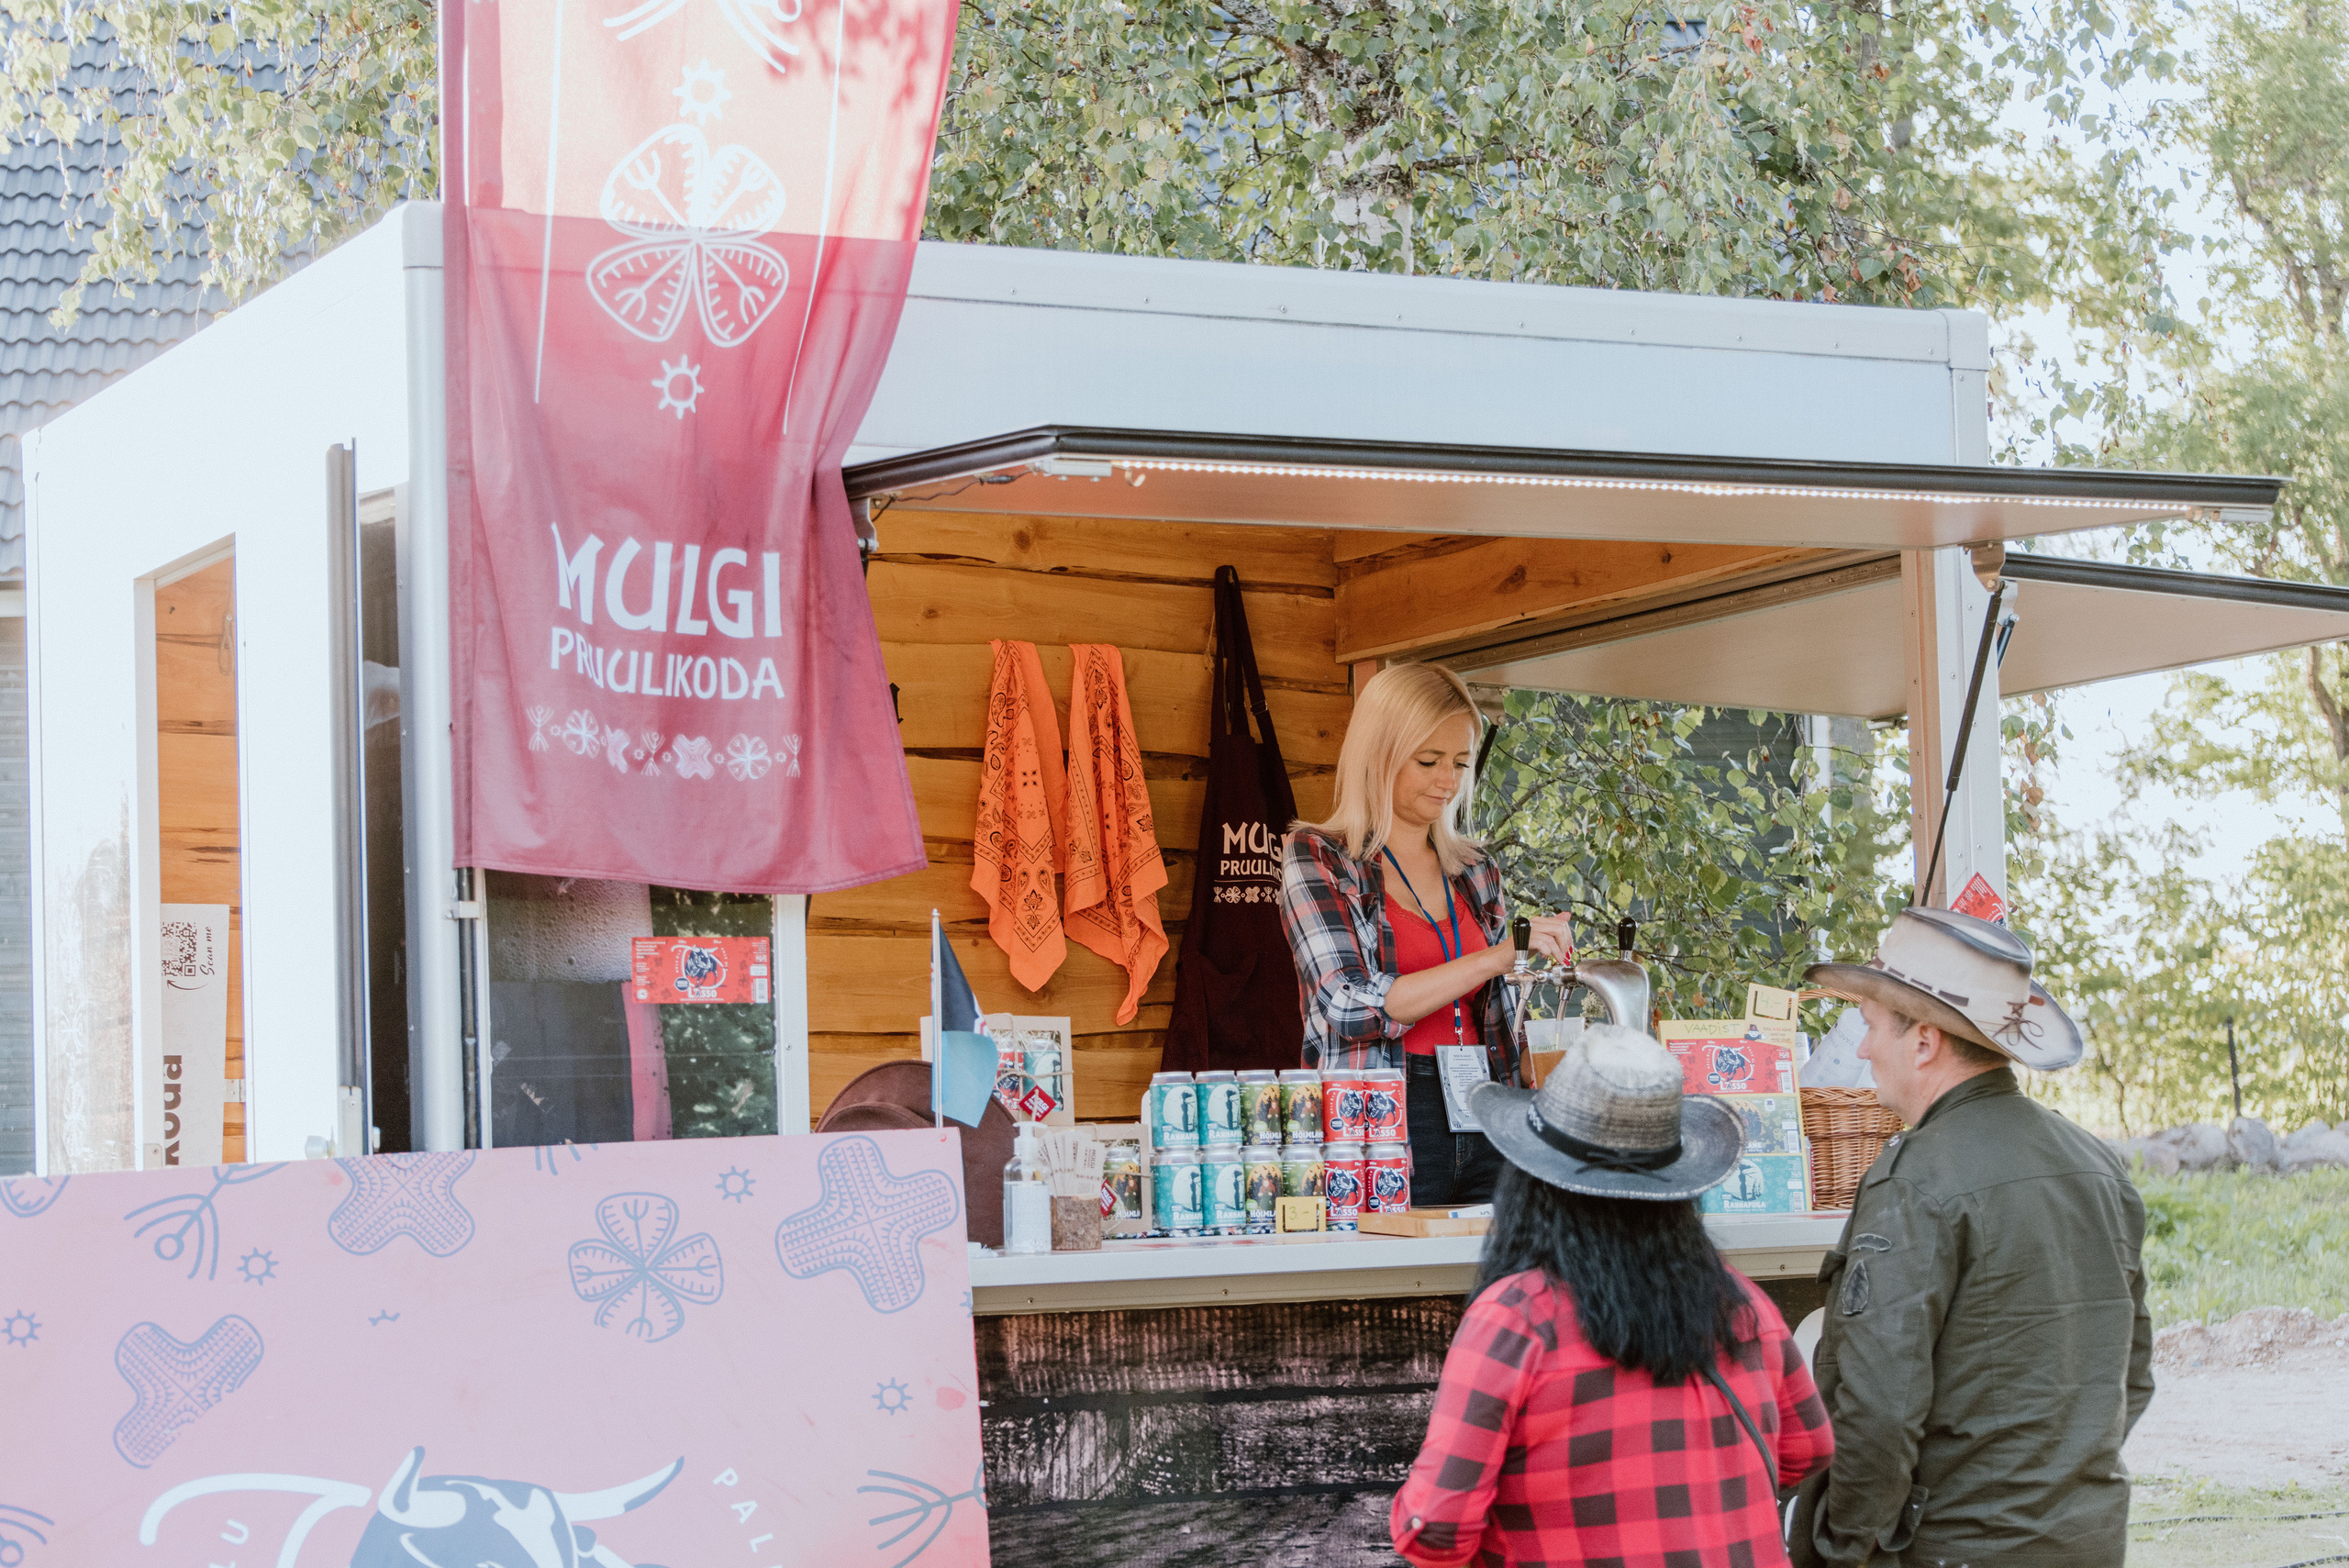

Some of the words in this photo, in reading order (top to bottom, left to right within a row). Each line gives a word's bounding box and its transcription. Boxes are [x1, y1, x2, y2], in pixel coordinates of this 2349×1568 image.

[551, 522, 783, 639] MULGI
[551, 627, 785, 701] PRUULIKODA
[205, 925, 213, 943] me
[199, 943, 216, 976] Scan
[688, 985, 718, 998] LASSO
[1720, 1081, 1747, 1091] LASSO
[1369, 1128, 1397, 1137] LASSO
[1330, 1207, 1358, 1217] LASSO
[712, 1467, 784, 1568] PAL
